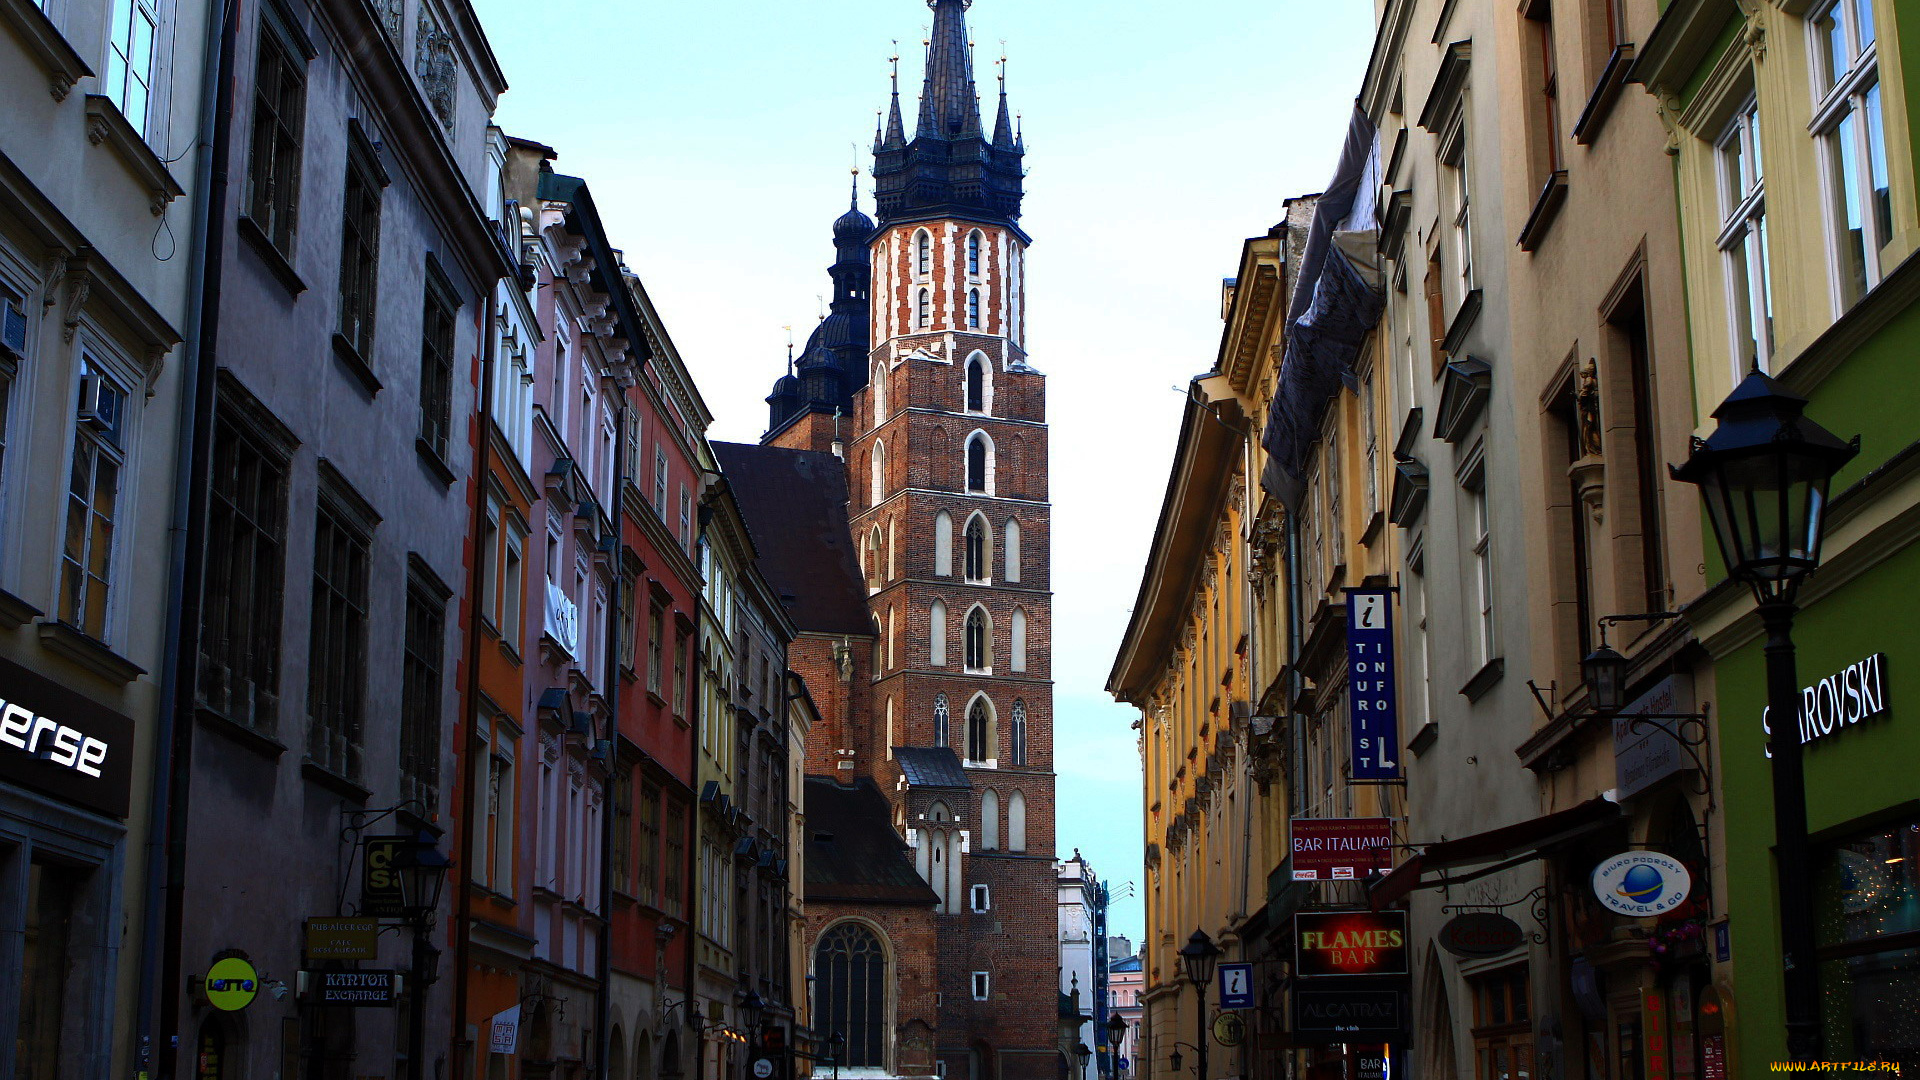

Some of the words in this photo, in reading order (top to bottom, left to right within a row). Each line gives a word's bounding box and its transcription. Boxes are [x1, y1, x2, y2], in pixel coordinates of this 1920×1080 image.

[1374, 643, 1387, 711] INFO
[1356, 643, 1371, 769] TOURIST
[1294, 837, 1323, 852] BAR
[1327, 836, 1391, 851] ITALIANO
[1602, 859, 1630, 877] BIURO
[1605, 893, 1653, 913] TRAVEL
[312, 923, 328, 931] PUB
[1301, 930, 1403, 950] FLAMES
[1450, 926, 1514, 945] Kebab
[1331, 951, 1377, 965] BAR
[208, 979, 255, 992] LOTTO
[325, 973, 390, 988] KANTOR
[1303, 1003, 1394, 1018] ALCATRAZ
[1360, 1058, 1381, 1070] BAR
